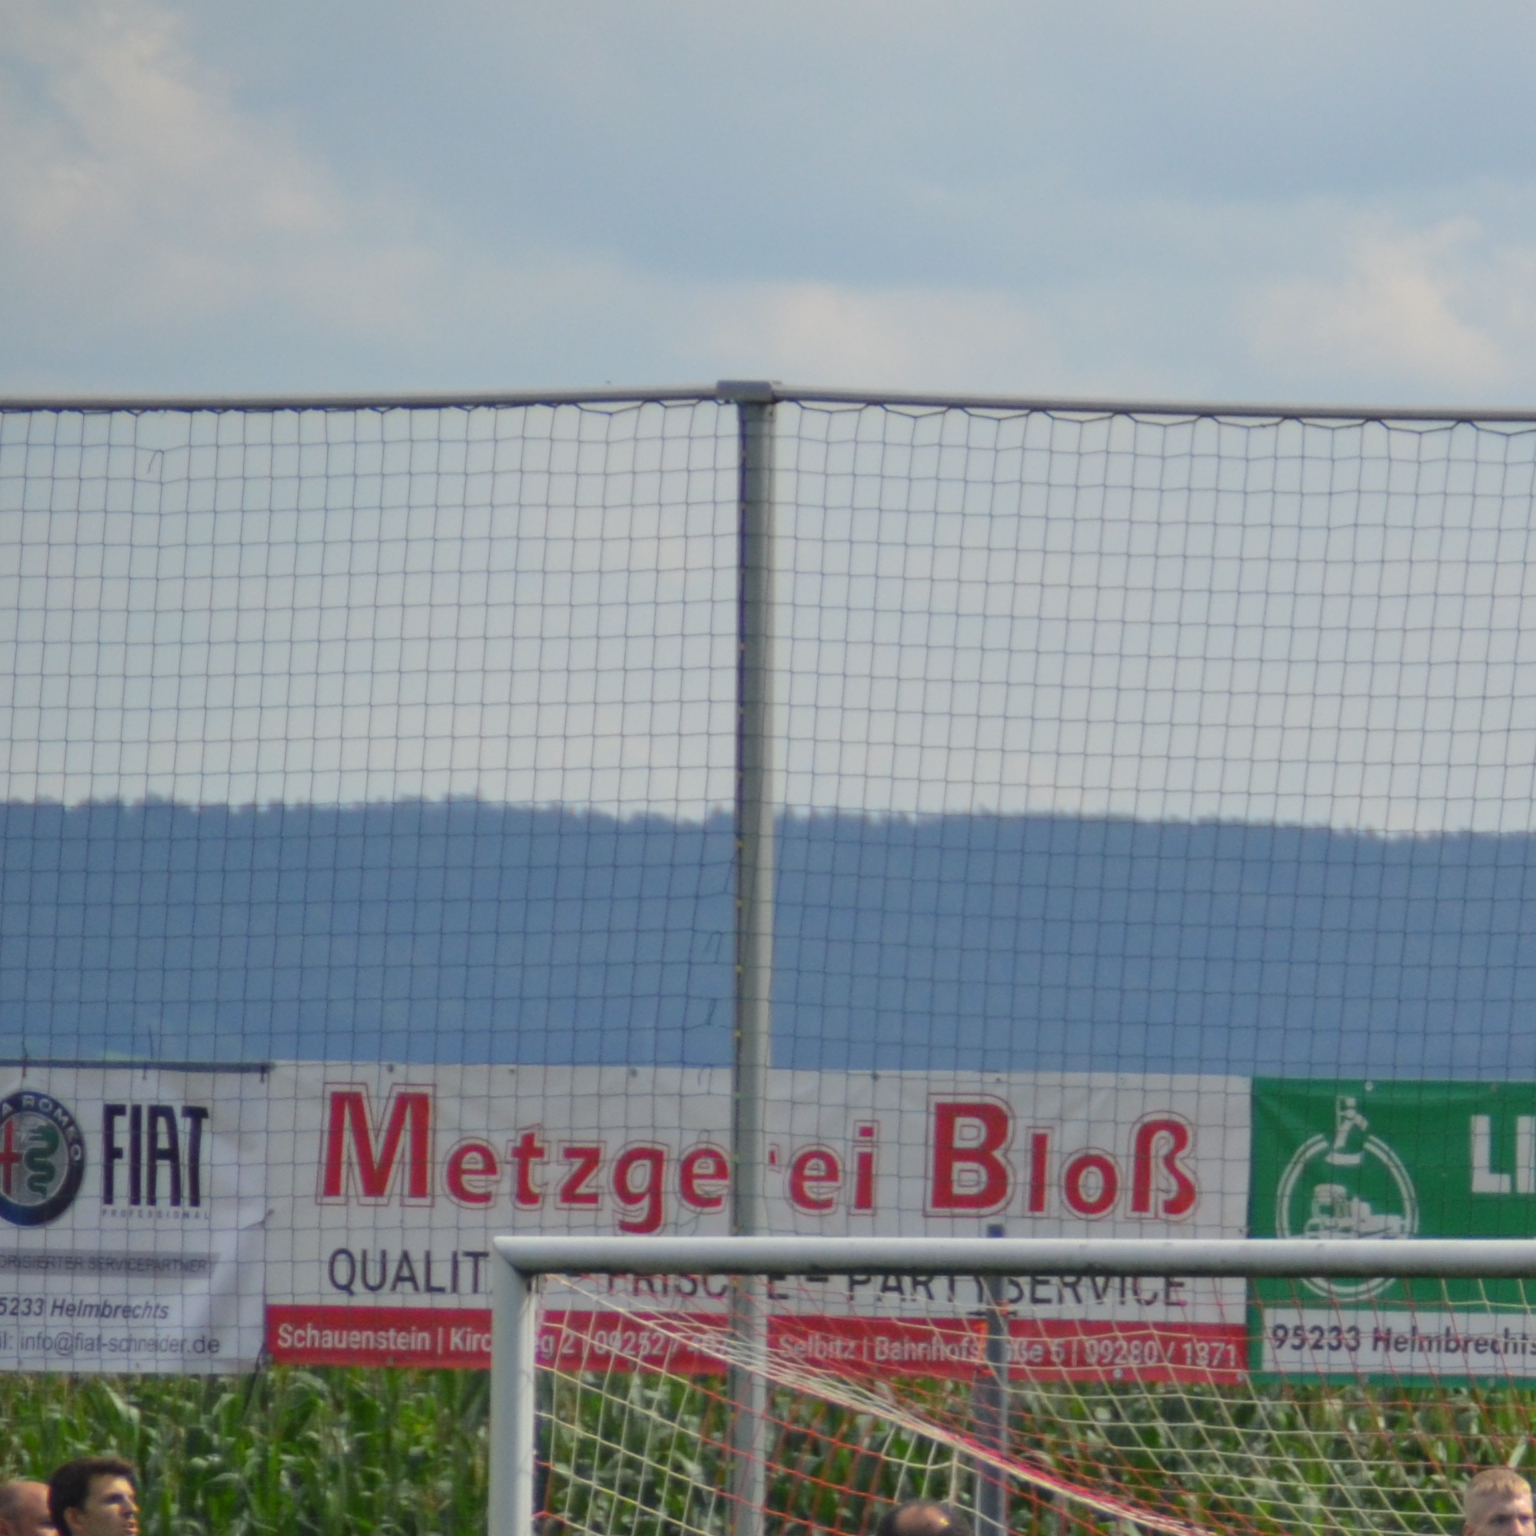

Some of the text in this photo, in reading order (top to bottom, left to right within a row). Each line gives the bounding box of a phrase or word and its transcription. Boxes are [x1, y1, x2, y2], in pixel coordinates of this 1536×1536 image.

[21, 1094, 83, 1162] ROMEO
[103, 1104, 209, 1207] FIAT
[923, 1093, 1199, 1221] Bloß
[102, 1208, 211, 1221] PROFESSIONAL
[88, 1257, 207, 1273] SERVICEPARTNER
[328, 1247, 491, 1296] QUALIT
[606, 1275, 789, 1300] FRISCE
[50, 1299, 170, 1320] Helmbrechts
[20, 1331, 221, 1357] info@fiat-schneider.de
[277, 1323, 431, 1351] Schauenstein
[778, 1334, 856, 1360] Selbitz
[1182, 1341, 1237, 1368] 1371
[1271, 1324, 1361, 1352] 95233
